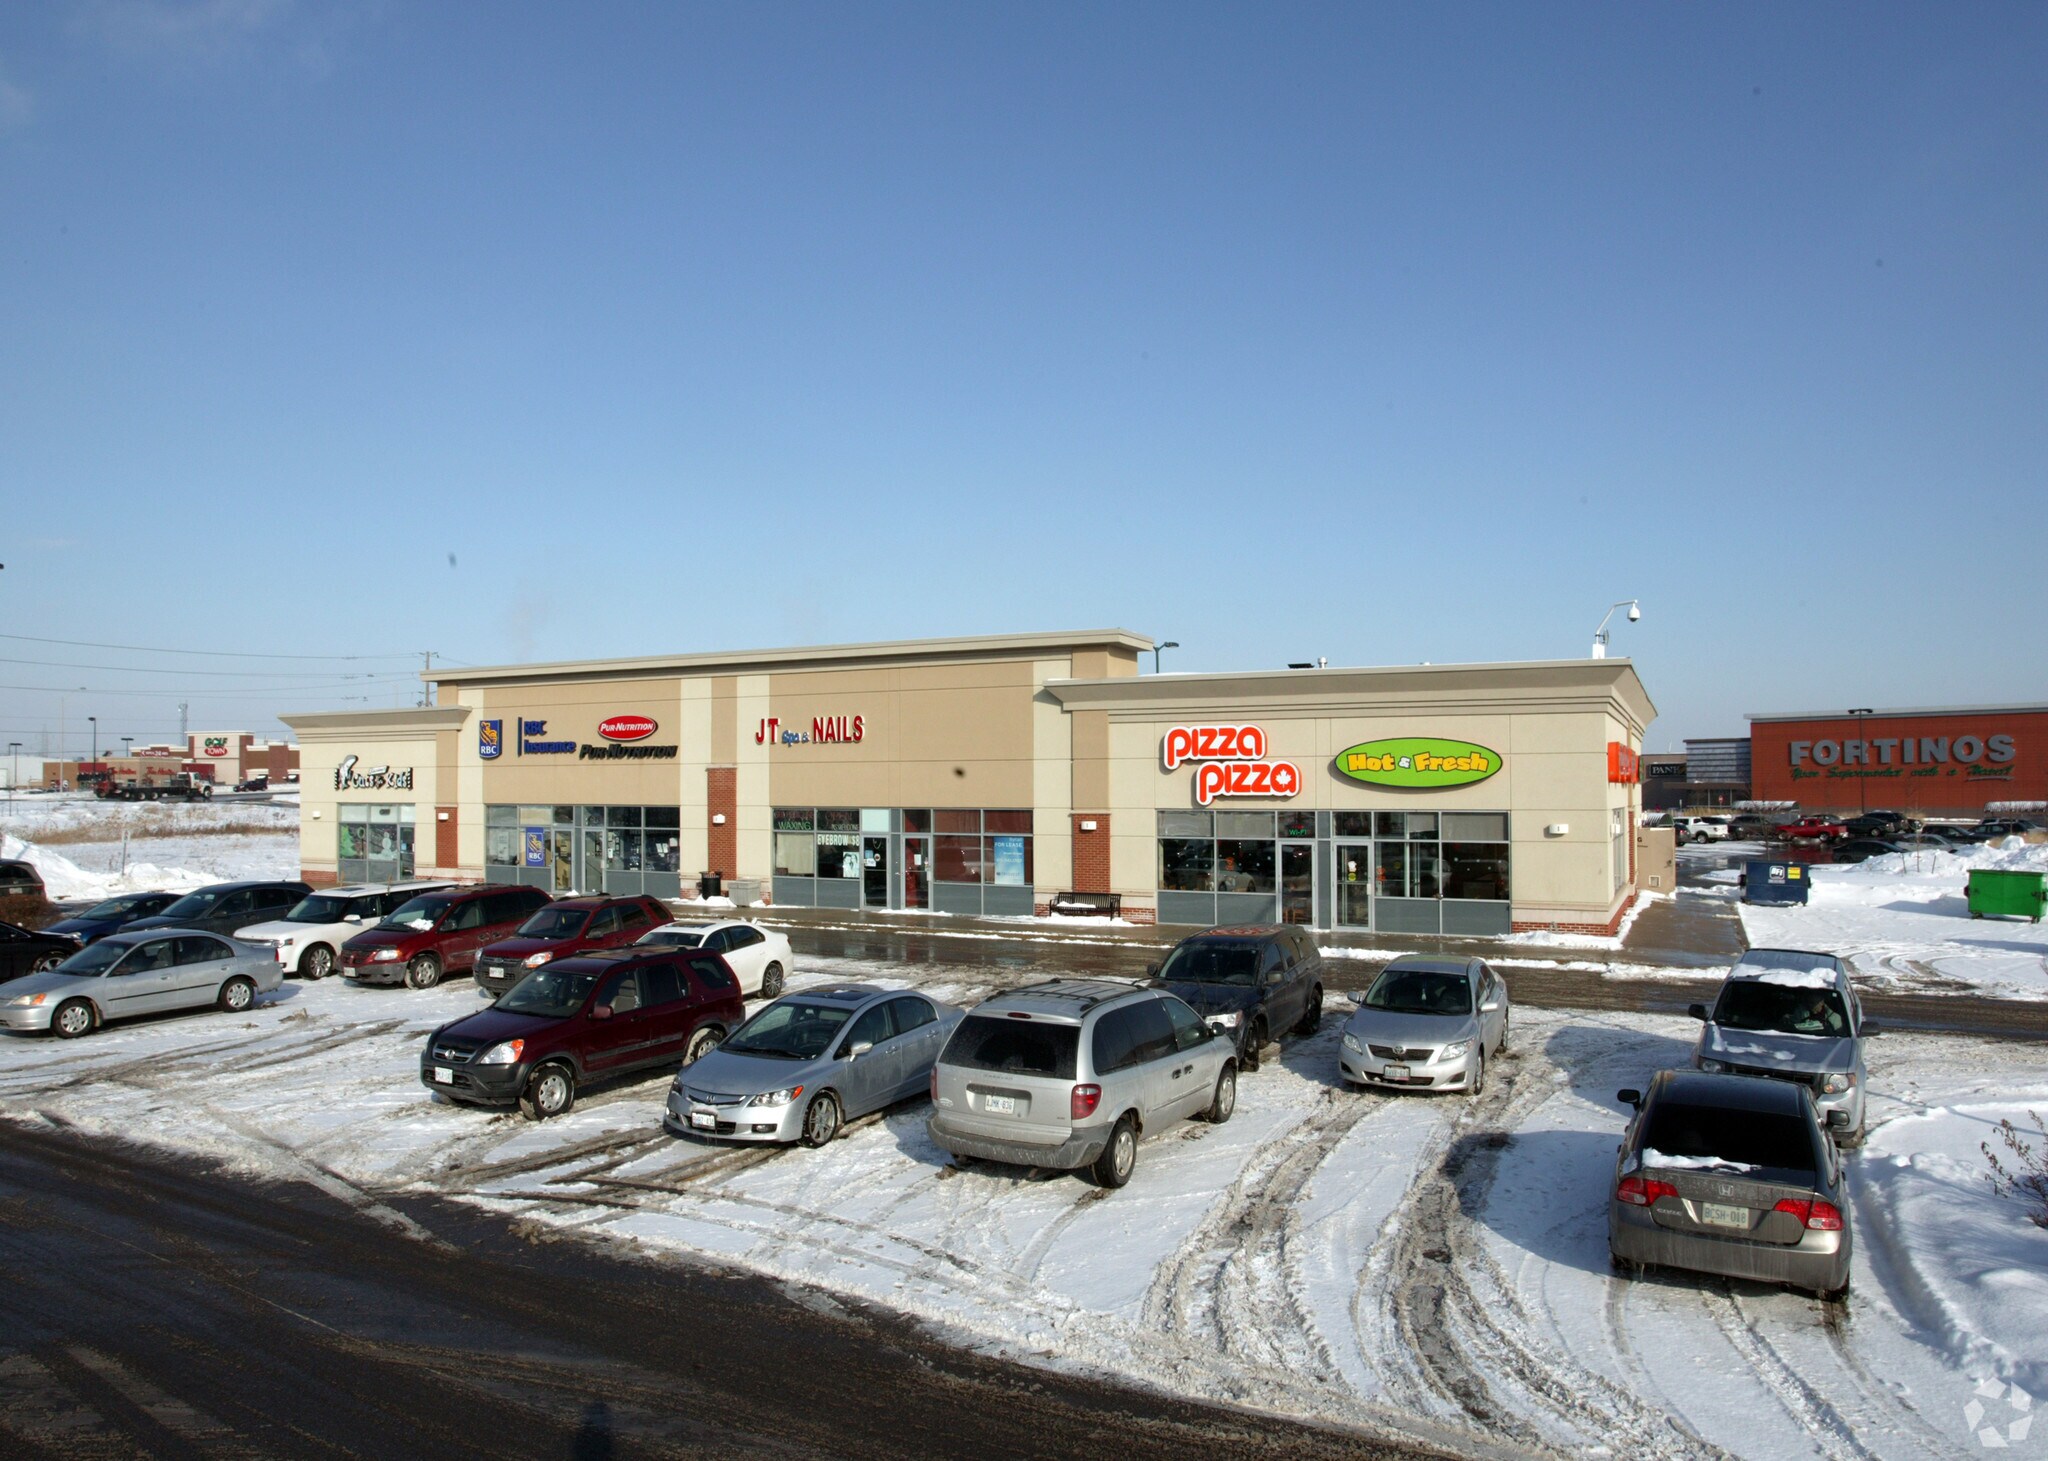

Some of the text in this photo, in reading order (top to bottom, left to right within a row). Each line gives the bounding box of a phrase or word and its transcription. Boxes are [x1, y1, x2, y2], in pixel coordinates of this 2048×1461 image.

[524, 720, 547, 736] RBC
[755, 718, 779, 744] JT
[813, 715, 865, 743] NAILS
[205, 737, 228, 747] GOLF
[524, 739, 577, 754] Insurance
[1167, 726, 1263, 768] pizza
[480, 746, 497, 754] RBC
[1790, 735, 2016, 765] FORTINOS
[1347, 751, 1489, 773] Hot & Fresh
[1199, 763, 1296, 803] pizza
[778, 821, 811, 830] WAXING
[817, 834, 860, 846] EYEBROW $8
[529, 851, 542, 860] RBC
